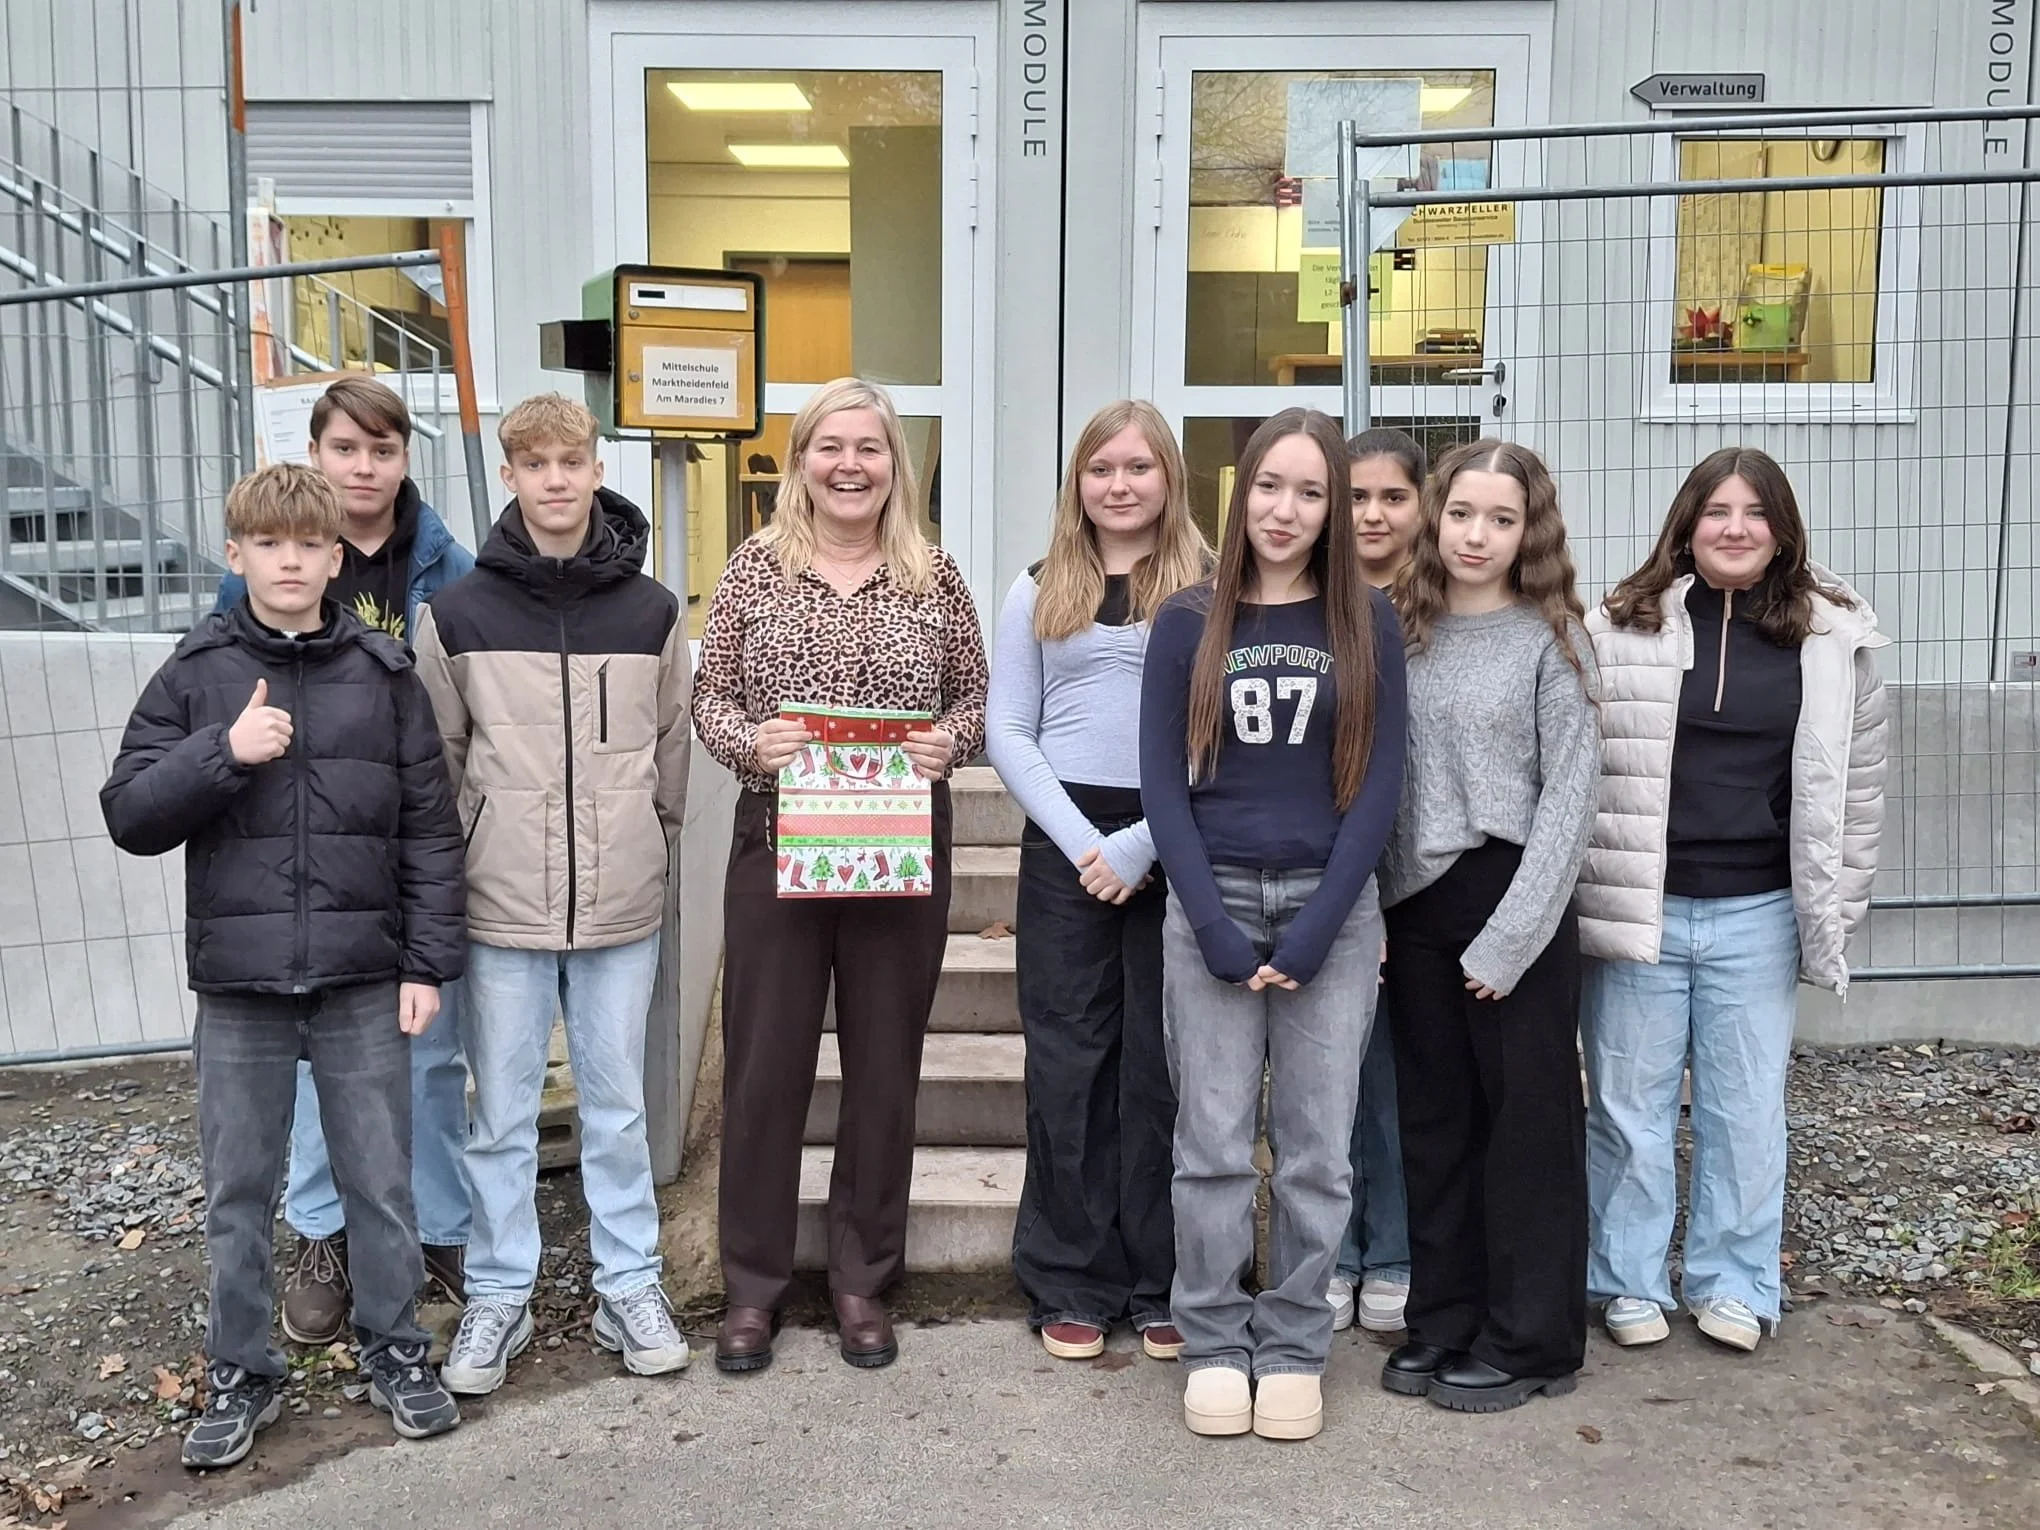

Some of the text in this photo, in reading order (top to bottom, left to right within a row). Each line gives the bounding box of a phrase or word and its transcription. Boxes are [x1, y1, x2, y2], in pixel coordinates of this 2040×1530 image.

[1023, 0, 1047, 157] MODULE
[1659, 81, 1757, 99] Verwaltung
[661, 362, 720, 374] Mittelschule
[651, 377, 730, 390] Marktheidenfeld
[655, 393, 726, 406] Am Maradies 7
[1230, 676, 1318, 745] 87
